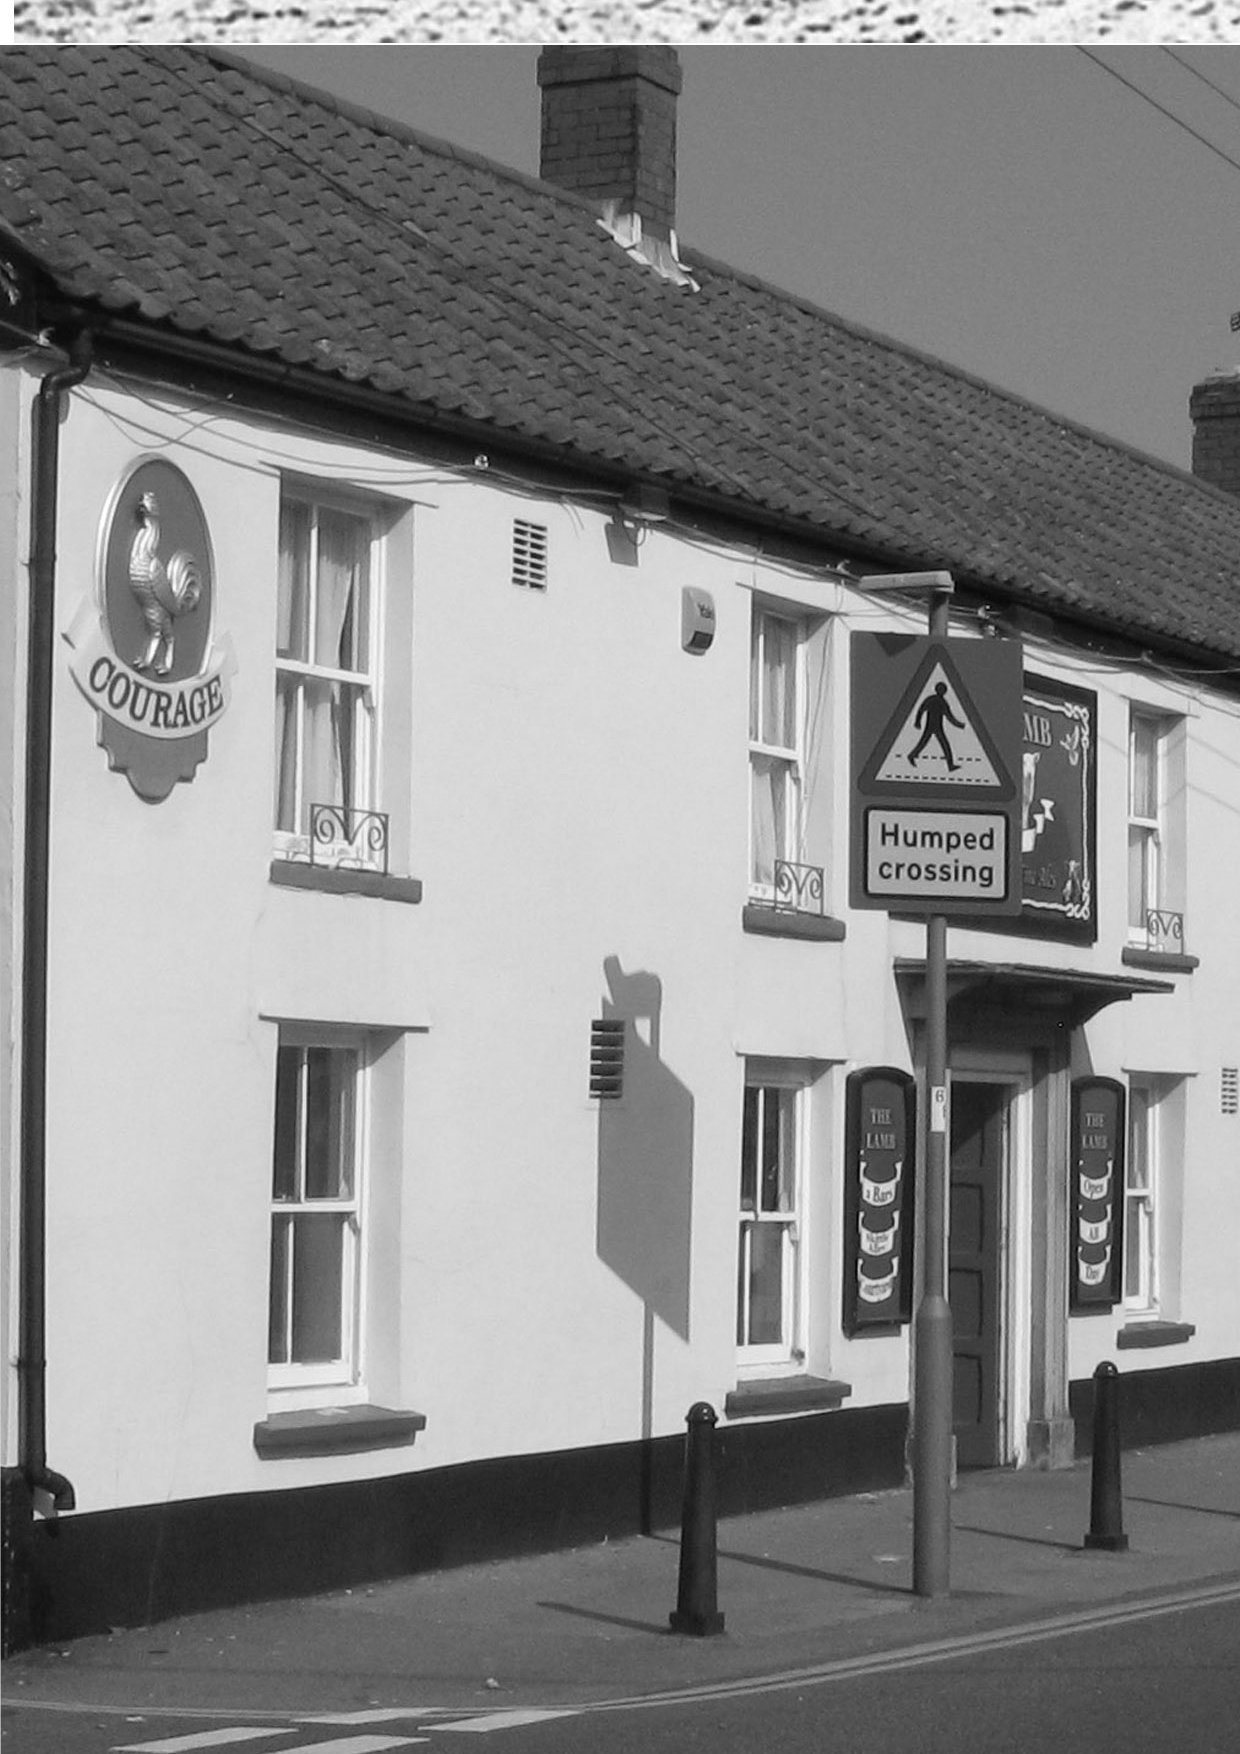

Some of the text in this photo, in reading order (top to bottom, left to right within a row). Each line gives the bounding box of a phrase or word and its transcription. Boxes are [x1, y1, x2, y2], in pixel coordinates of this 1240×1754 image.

[90, 656, 223, 728] COURAGE
[1022, 712, 1052, 747] MB
[881, 823, 994, 854] Humped
[879, 858, 994, 887] crossing
[870, 1107, 892, 1125] THE
[866, 1132, 896, 1150] LAMB
